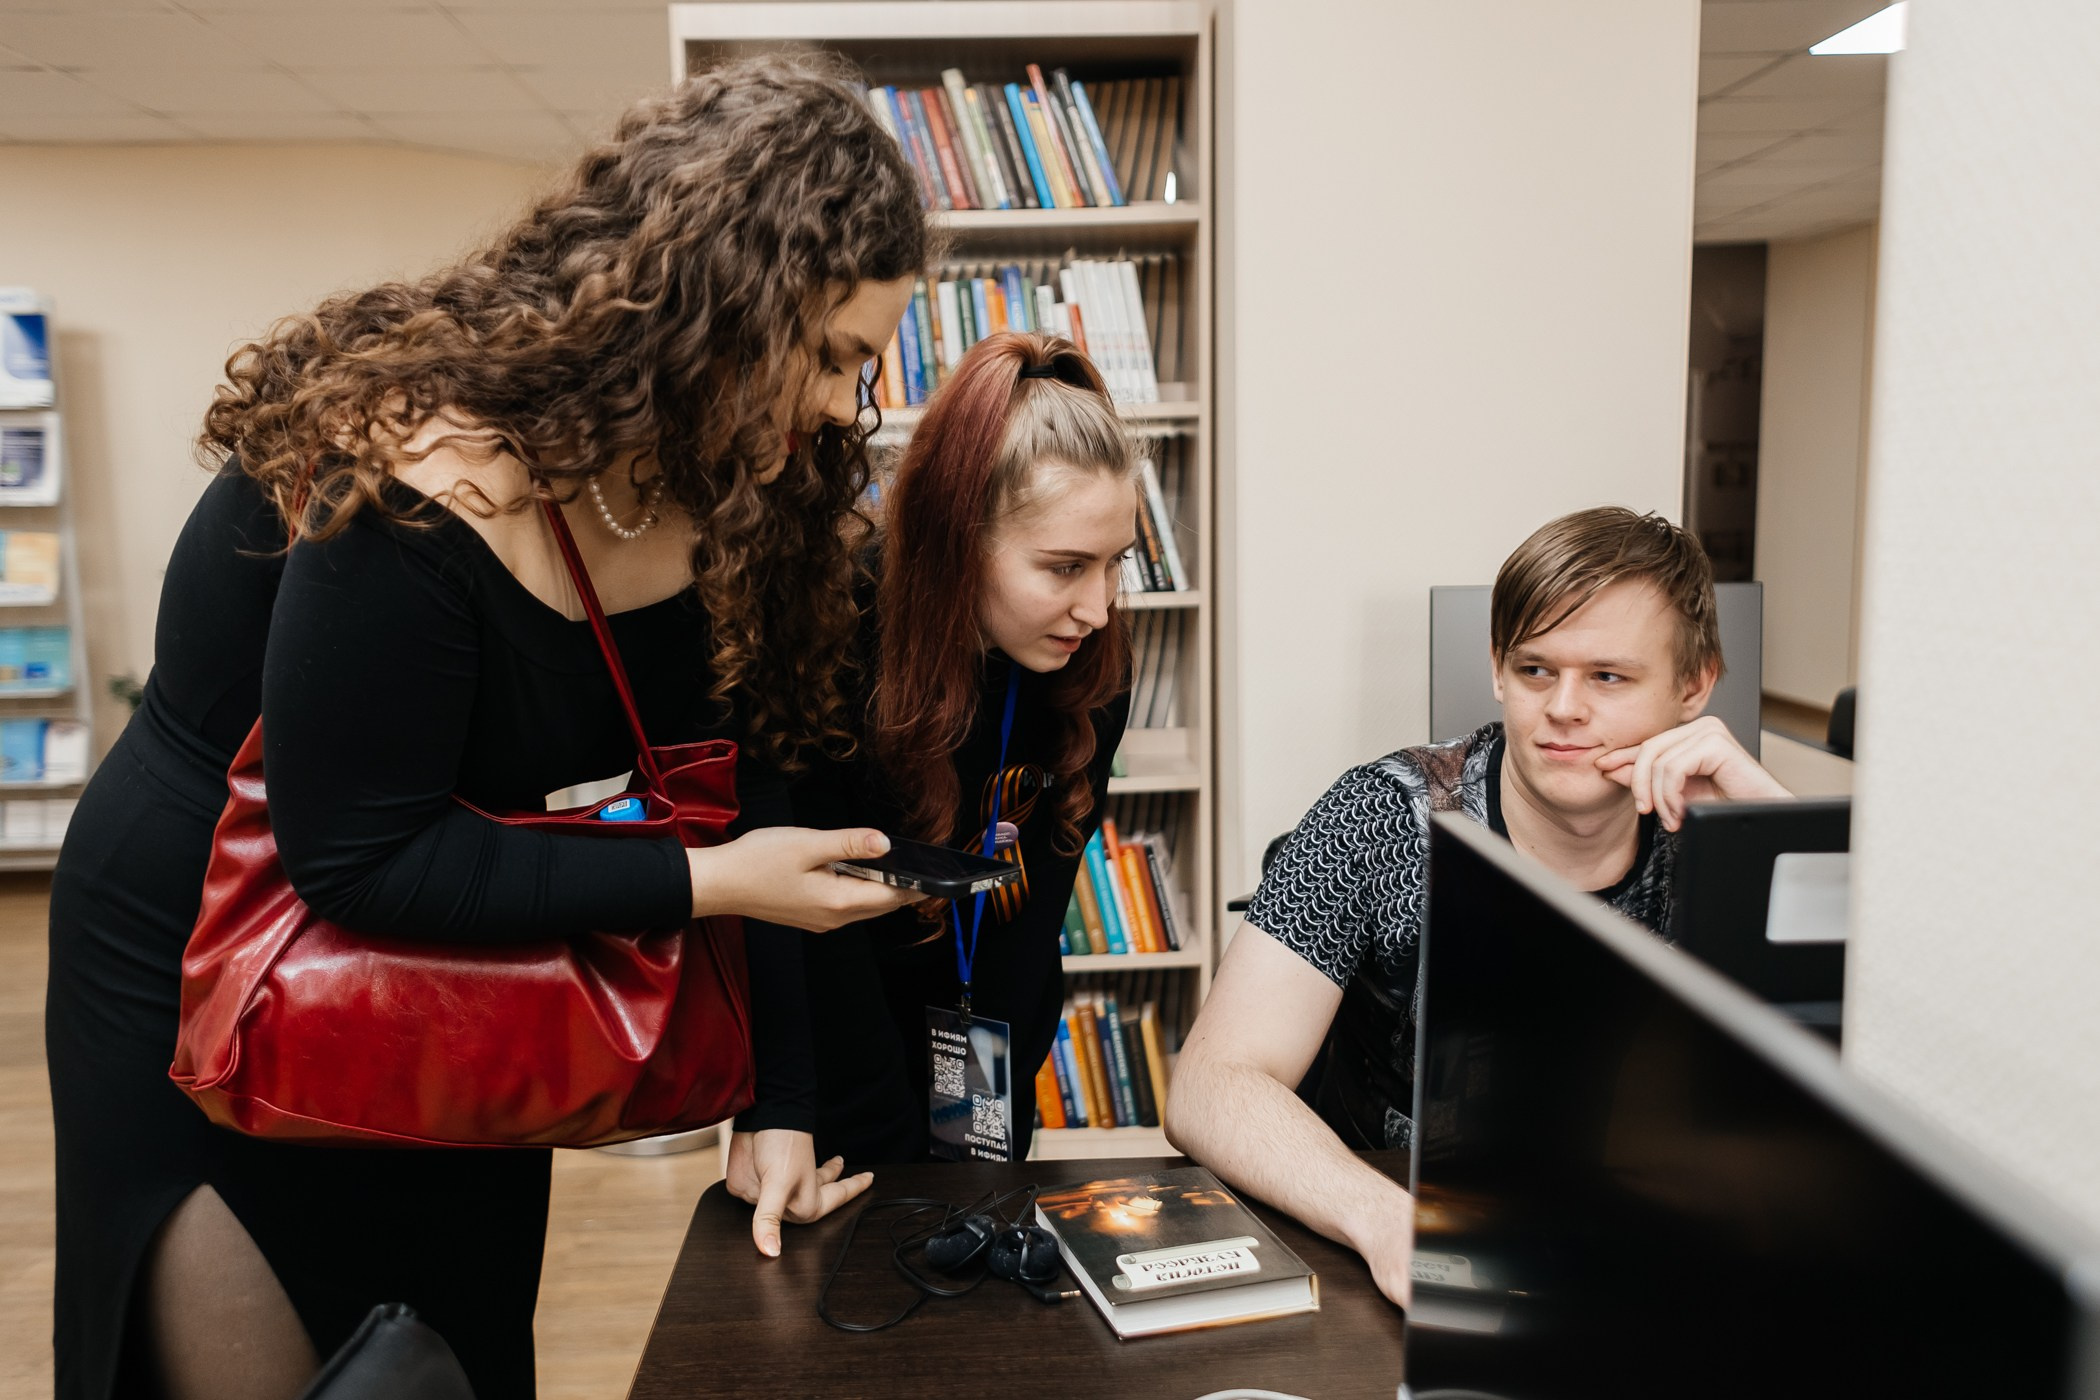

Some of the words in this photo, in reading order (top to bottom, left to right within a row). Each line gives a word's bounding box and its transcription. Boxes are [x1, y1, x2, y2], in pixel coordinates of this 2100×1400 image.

[931, 1028, 936, 1036] В
[938, 1030, 967, 1043] ИФИЯМ
[932, 1041, 966, 1055] ХОРОШО
[965, 1133, 1007, 1151] ПОСТУПАЙ
[971, 1148, 976, 1156] В
[978, 1151, 1007, 1162] ИФИЯМ
